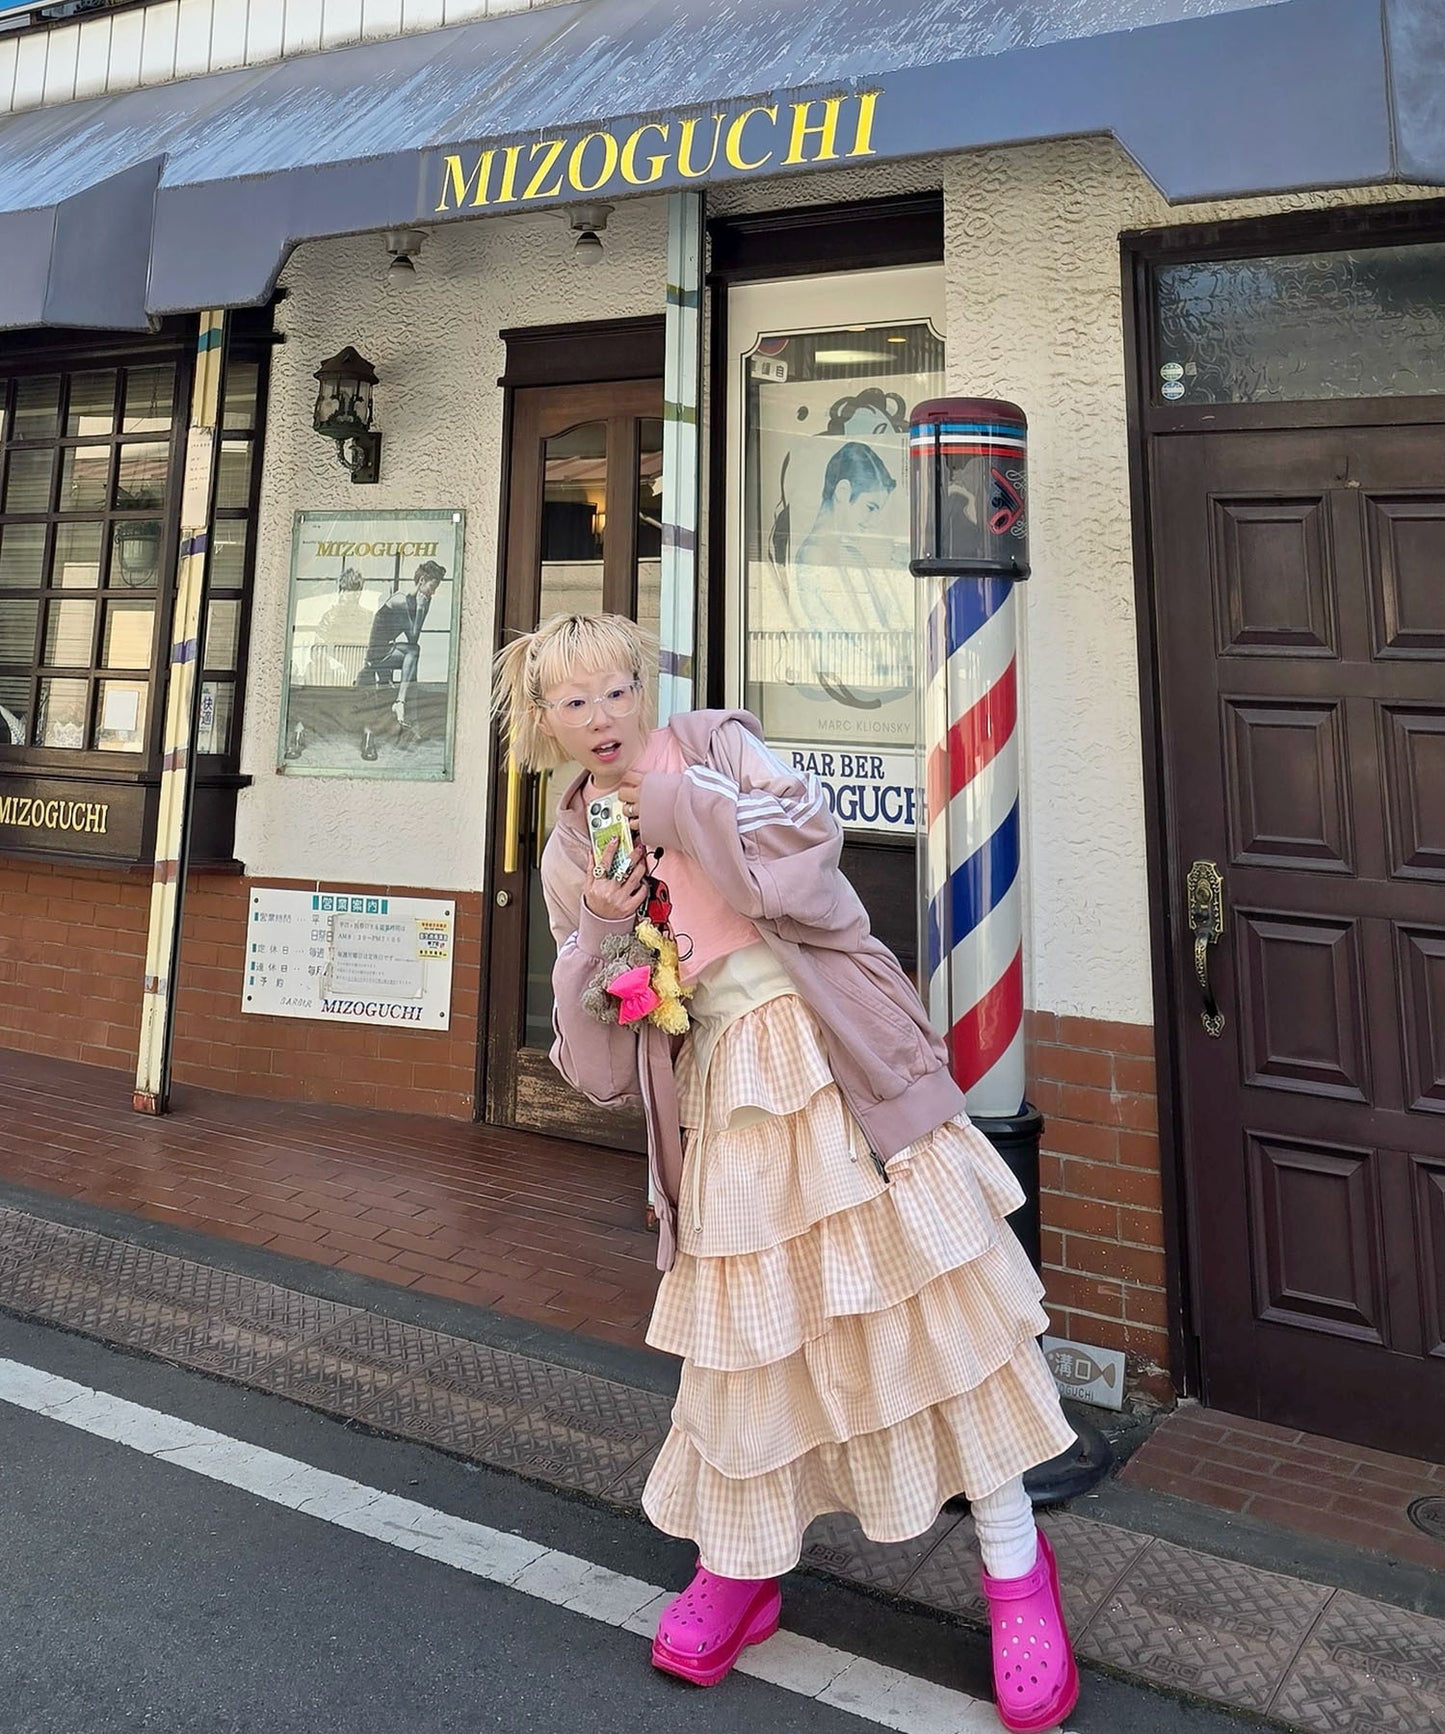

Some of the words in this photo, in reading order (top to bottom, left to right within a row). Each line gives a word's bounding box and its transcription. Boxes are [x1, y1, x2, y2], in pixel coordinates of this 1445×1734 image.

[435, 89, 885, 212] MIZOGUCHI
[315, 541, 438, 557] MIZOGUCHI
[818, 719, 851, 731] MARC
[856, 720, 911, 734] KLIONSKY
[0, 796, 108, 833] MIZOGUCHI
[322, 896, 379, 913] 営業案内
[320, 998, 423, 1021] MIZOGUCHI
[1054, 1352, 1091, 1381] 溝口
[1055, 1382, 1094, 1401] OGUCHI
